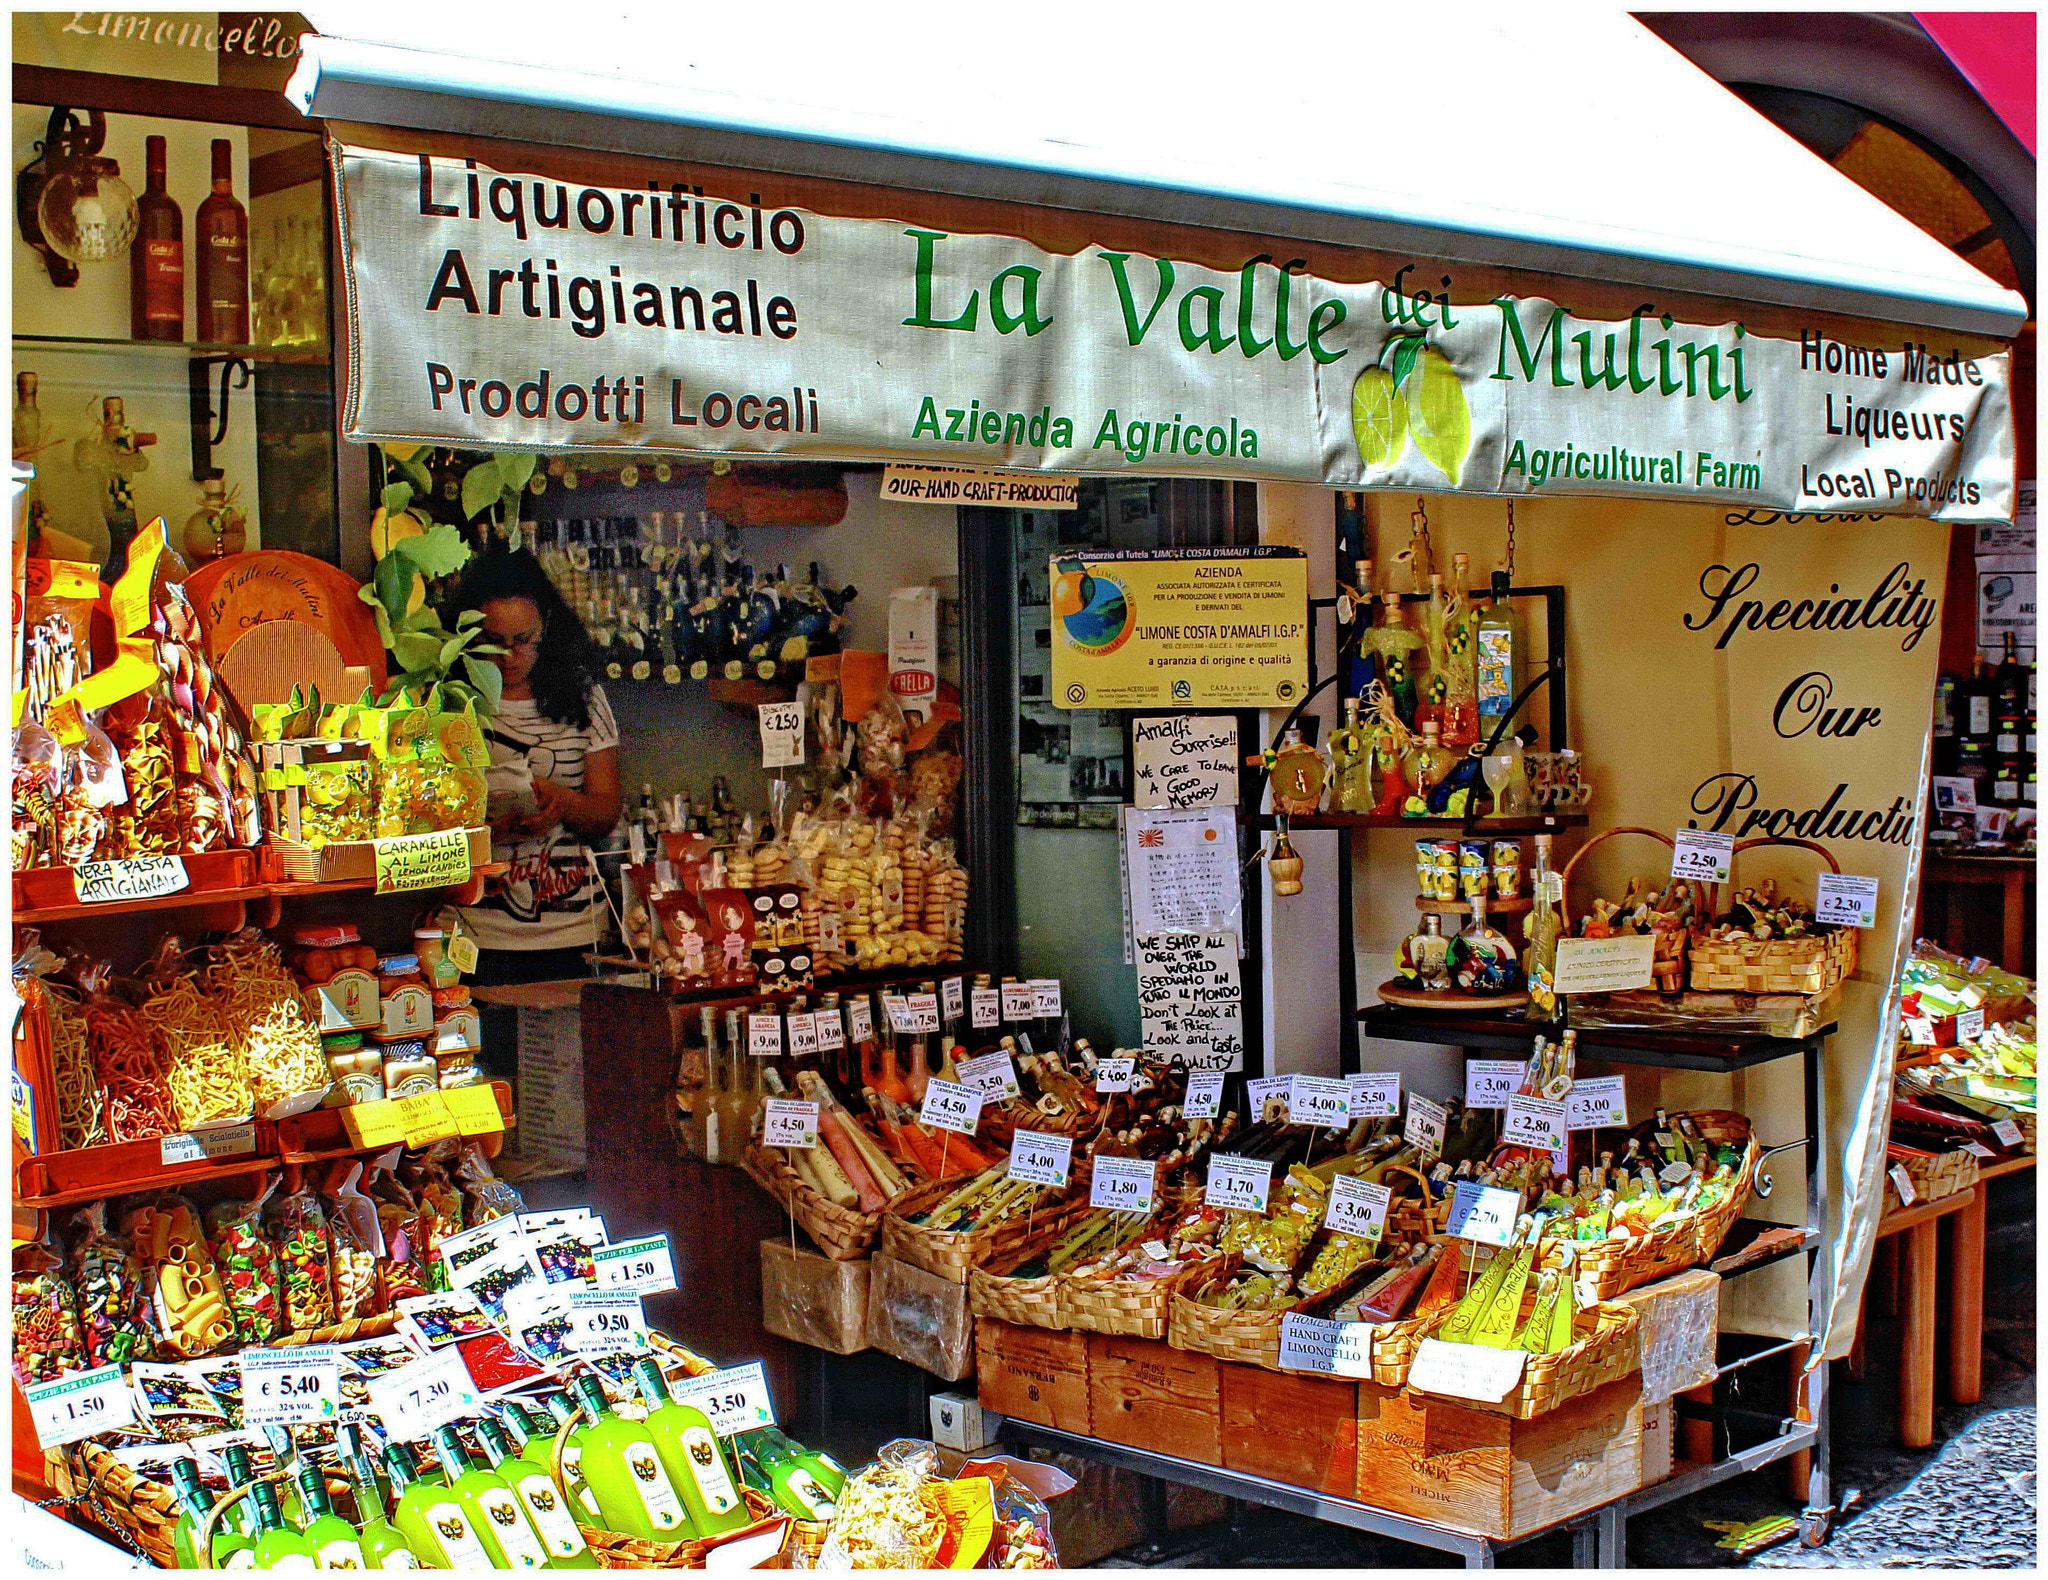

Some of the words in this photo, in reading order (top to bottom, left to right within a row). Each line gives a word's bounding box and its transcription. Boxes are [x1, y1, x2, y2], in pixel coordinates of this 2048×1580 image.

[419, 153, 805, 255] Liquorificio
[426, 249, 798, 339] Artigianale
[902, 229, 1053, 337] La
[1098, 248, 1348, 364] Valle
[1382, 265, 1458, 330] dei
[1490, 298, 1753, 403] Mulini
[1801, 329, 1888, 379] Home
[1903, 343, 1983, 386] Made
[426, 362, 645, 422] Prodotti
[672, 379, 819, 433] Locali
[1826, 393, 1965, 447] Liqueurs
[911, 397, 1073, 449] Azienda
[1093, 409, 1258, 463] Agricola
[1505, 440, 1684, 488] Agricultural
[1696, 453, 1762, 490] Farm
[1802, 464, 1876, 500] Local
[1888, 468, 1981, 506] Products
[224, 564, 260, 594] Valle
[1194, 567, 1242, 578] AZIENDA
[1156, 582, 1191, 590] ASSOCIATA
[1193, 581, 1236, 589] AUTORIZZATA
[1177, 592, 1217, 600] PRODUZIONE
[1224, 592, 1252, 600] VENDITA
[1683, 562, 1937, 652] Speciality
[1184, 625, 1217, 639] COSTA
[1220, 625, 1270, 639] D'AMALFI
[1157, 656, 1197, 668] garanzia
[1200, 655, 1209, 665] di
[1213, 655, 1245, 667] origine
[1258, 654, 1291, 666] qualità
[1773, 672, 1881, 738] Our
[765, 717, 774, 730] €
[1136, 718, 1192, 742] Amalfi
[1170, 731, 1236, 755] Surprise!!
[1136, 764, 1154, 779] WE
[1160, 764, 1190, 777] CARE
[1213, 759, 1237, 775] LEAVE
[1149, 782, 1159, 795] A
[1167, 778, 1200, 793] GOOD
[1168, 783, 1219, 809] MEMORY
[378, 833, 464, 856] CARAMELLE
[73, 862, 112, 879] VERA
[118, 856, 174, 875] PASTA
[389, 857, 410, 868] AL
[1680, 853, 1688, 864] €
[1691, 852, 1717, 868] 2,50
[397, 866, 430, 877] LEMON
[1824, 899, 1831, 909] €
[1834, 897, 1861, 912] 2,30
[1137, 937, 1159, 950] WE
[1205, 937, 1225, 949] ALL
[1145, 952, 1176, 963] OVER
[1182, 950, 1204, 962] THE
[1164, 961, 1217, 975] WORLD
[1214, 972, 1228, 984] IN
[1194, 986, 1240, 1001] MONDO
[1012, 1000, 1030, 1011] 7,00
[1142, 1004, 1179, 1019] Don't
[1224, 1005, 1237, 1018] at
[759, 1035, 779, 1048] 9,00
[1186, 1031, 1209, 1045] and
[1211, 1034, 1244, 1054] taste
[1145, 1050, 1164, 1062] THE
[1099, 1070, 1105, 1081] €
[930, 1079, 950, 1088] CREMA
[960, 1086, 982, 1097] LIMONE
[1475, 1081, 1481, 1090] €
[1484, 1078, 1510, 1091] 3,00
[931, 1098, 938, 1107] €
[940, 1097, 966, 1113] 4,50
[1299, 1098, 1306, 1107] €
[1308, 1096, 1336, 1111] 4,00
[1360, 1091, 1386, 1104] 5,50
[1572, 1104, 1579, 1113] €
[1582, 1099, 1609, 1113] 3,00
[771, 1120, 777, 1129] €
[780, 1117, 804, 1131] 4,50
[1411, 1117, 1417, 1127] €
[1418, 1118, 1435, 1137] 3,00
[1513, 1117, 1519, 1127] €
[1523, 1117, 1550, 1133] 2,80
[1018, 1154, 1025, 1163] €
[1028, 1153, 1054, 1168] 4,00
[1100, 1182, 1106, 1190] €
[1110, 1179, 1137, 1194] 1,80
[1215, 1179, 1222, 1189] €
[1226, 1177, 1253, 1193] 1,70
[1335, 1202, 1342, 1213] €
[1345, 1202, 1371, 1220] 3,00
[1459, 1209, 1467, 1219] €
[611, 1272, 617, 1282] €
[622, 1261, 654, 1281] 1,50
[589, 1319, 595, 1331] €
[597, 1313, 629, 1332] 9,50
[1289, 1328, 1320, 1341] HAND
[1322, 1333, 1359, 1346] CRAFT
[243, 1351, 295, 1361] LIMONCELLO
[295, 1350, 303, 1358] DI
[304, 1349, 334, 1357] AMALFI
[1287, 1342, 1361, 1361] LIMONCELLO
[1312, 1360, 1338, 1372] I.G.P.
[1007, 1365, 1056, 1384] BERSANO
[261, 1382, 270, 1396] €
[280, 1375, 320, 1397] 5,40
[708, 1393, 746, 1415] 3,50
[1411, 1485, 1451, 1503] MICELI
